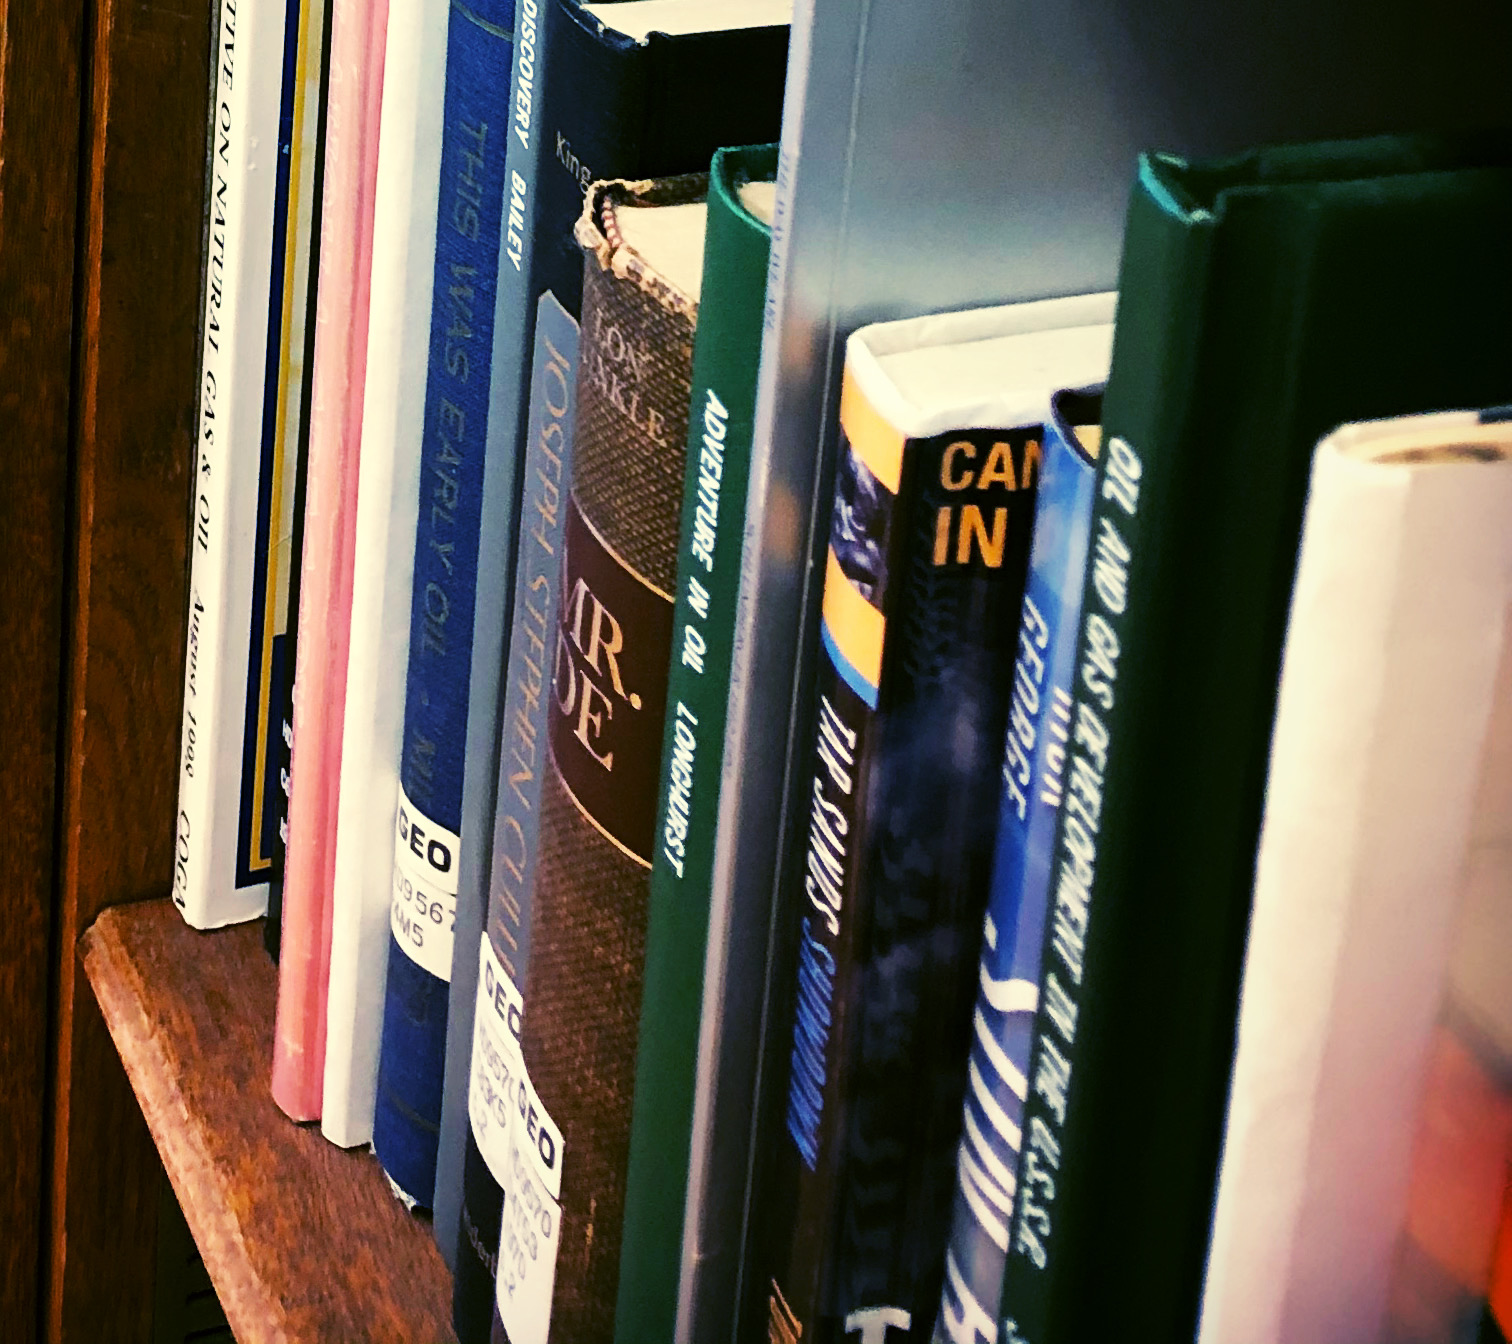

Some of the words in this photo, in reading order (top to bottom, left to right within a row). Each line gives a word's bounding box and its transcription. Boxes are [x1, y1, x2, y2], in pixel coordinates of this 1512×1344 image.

[217, 99, 233, 155] ON
[449, 117, 487, 247] THIS
[507, 170, 525, 272] BAILEY
[205, 164, 231, 354] NATURAL
[438, 254, 477, 383] WAS
[200, 370, 219, 444] GAS
[528, 334, 572, 554] JOSEPH
[430, 400, 467, 573] EARLY
[692, 389, 730, 573] ADVENTURE
[1100, 437, 1144, 516] OIL
[194, 493, 211, 556] OIL
[932, 505, 1009, 568] IN
[1092, 516, 1133, 614] AND
[421, 582, 452, 664] OIL
[687, 575, 709, 621] IN
[682, 624, 707, 674] OIL
[1081, 612, 1122, 712] GAS
[665, 700, 701, 879] LONGHURST
[817, 694, 858, 796] TAR
[397, 805, 452, 873] GEO
[803, 777, 851, 936] SANDS
[1051, 700, 1112, 985] DEVELOPMENT
[484, 960, 523, 1039] GEO
[1043, 971, 1079, 1043] IN
[517, 1081, 556, 1170] GEO
[1036, 1033, 1072, 1126] THE
